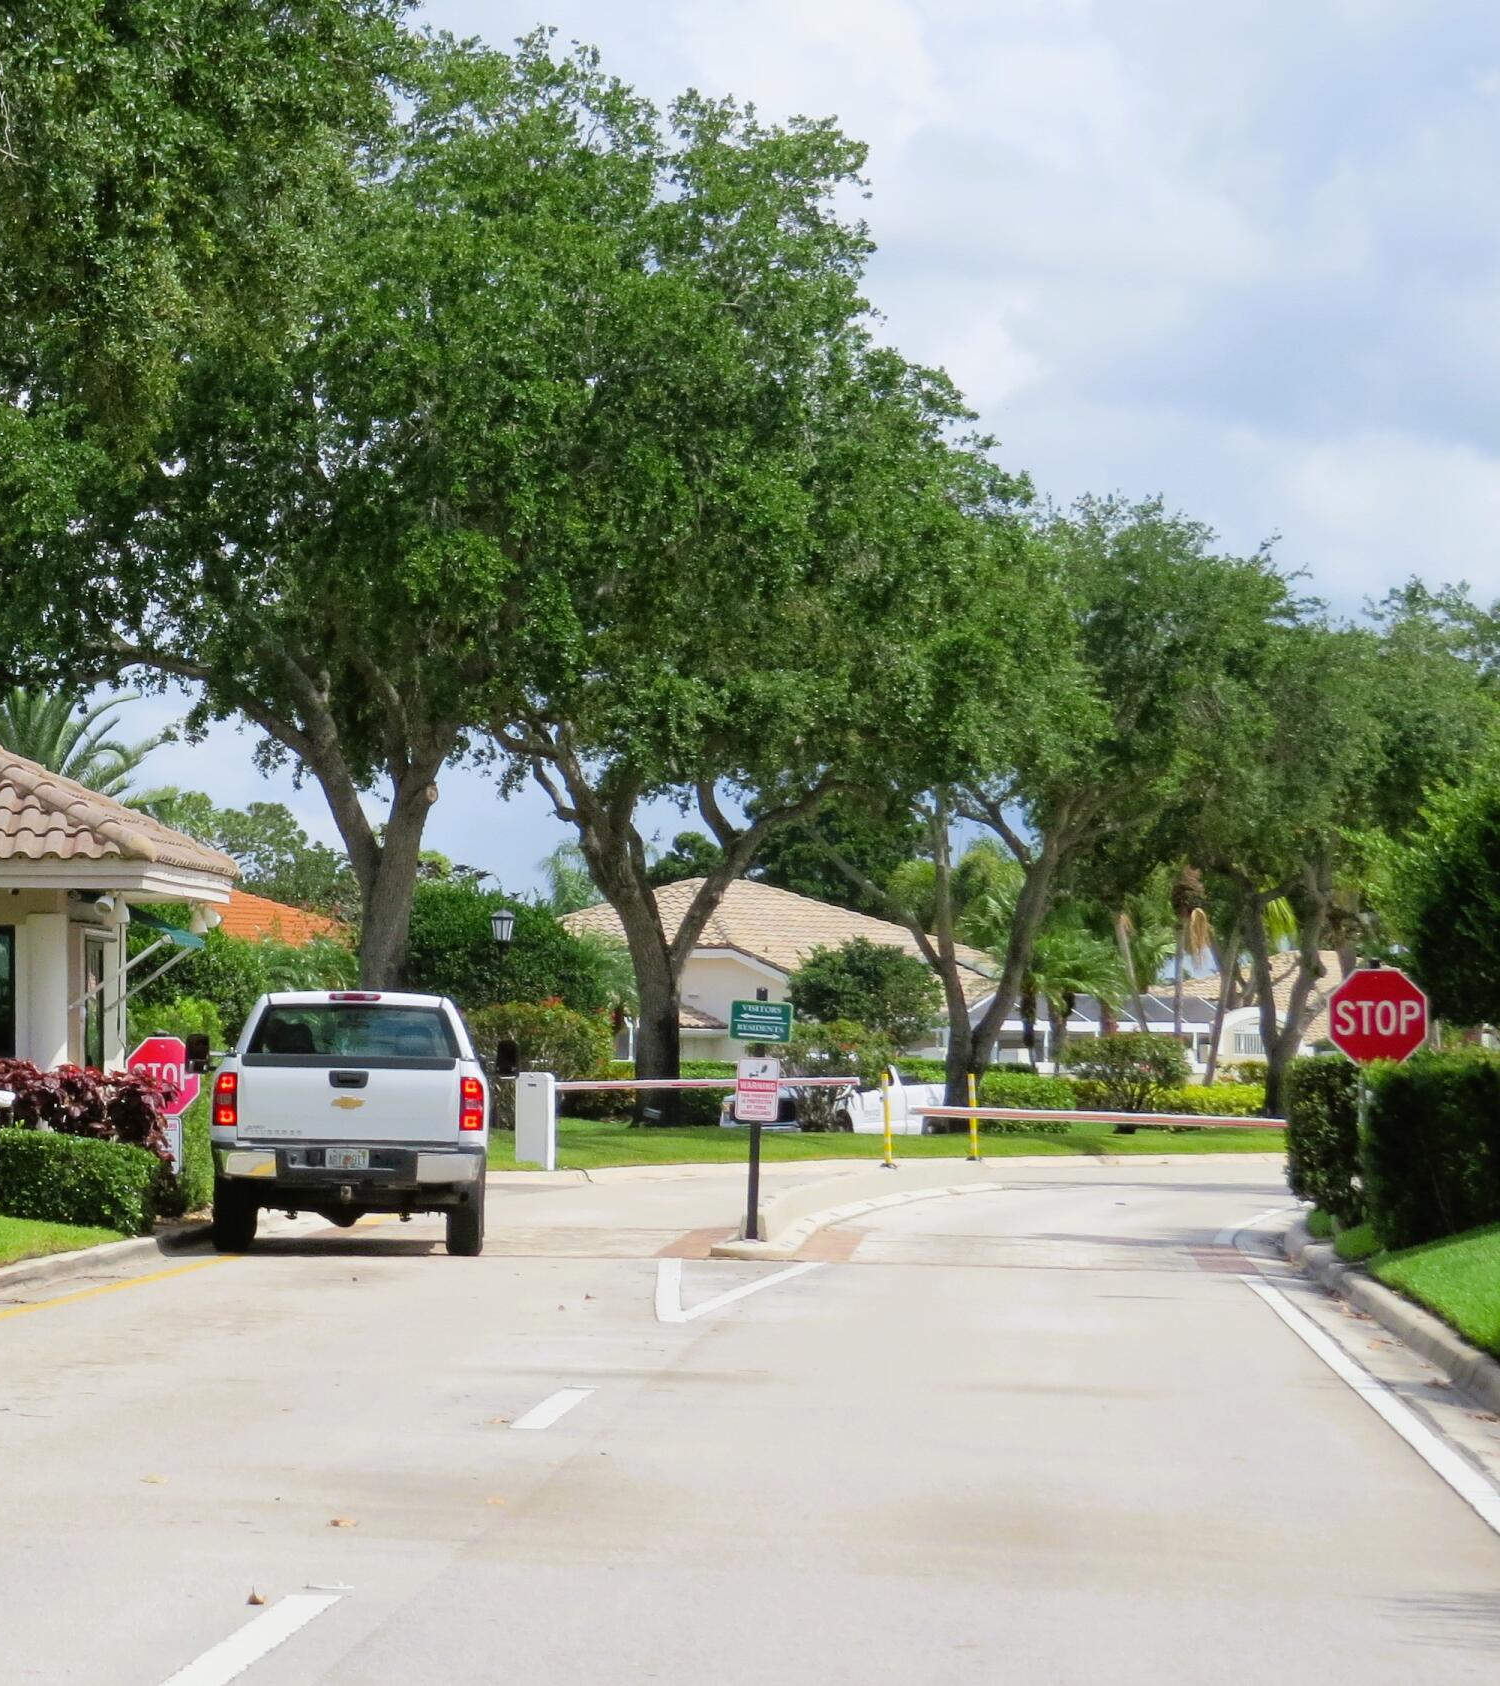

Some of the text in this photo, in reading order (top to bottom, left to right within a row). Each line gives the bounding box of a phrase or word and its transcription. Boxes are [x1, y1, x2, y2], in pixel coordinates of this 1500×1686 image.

[742, 1004, 782, 1014] VISITORS
[1335, 1000, 1421, 1036] STOP
[737, 1023, 784, 1033] RESIDENTS
[740, 1081, 776, 1091] WARNING
